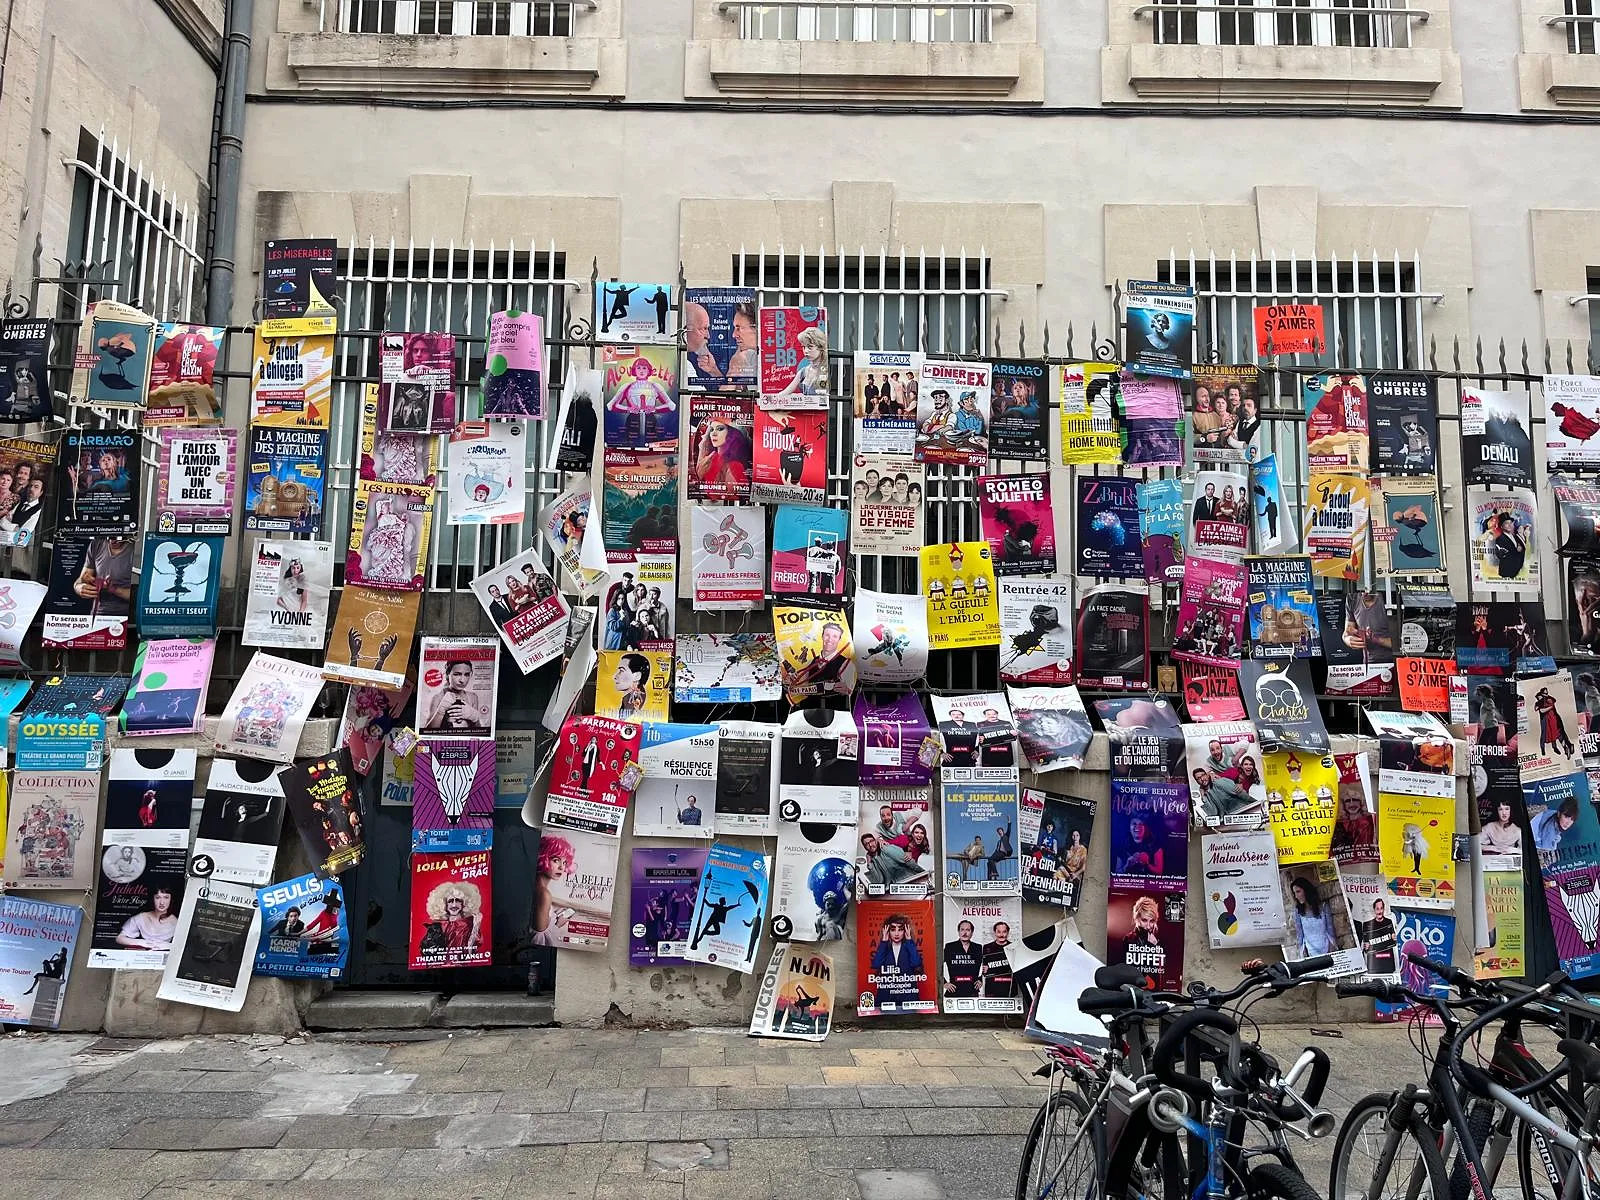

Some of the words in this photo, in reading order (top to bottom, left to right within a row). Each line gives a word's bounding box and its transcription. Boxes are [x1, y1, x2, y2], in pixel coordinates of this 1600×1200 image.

[268, 251, 282, 260] LES
[283, 248, 333, 259] MISÉRABLES
[1153, 297, 1193, 309] FRANKENSTEIN
[1268, 307, 1287, 317] ON
[1290, 306, 1307, 316] VA
[503, 323, 531, 332] compris
[1264, 318, 1316, 332] S'AIMER
[3, 330, 46, 340] OMBRES
[500, 336, 516, 344] bleu
[183, 352, 192, 361] DE
[182, 359, 197, 368] CHEZ
[181, 366, 203, 376] MAXIM
[266, 361, 303, 382] Chioggia
[932, 365, 966, 379] DÎNER
[967, 372, 987, 387] EX
[1373, 387, 1428, 397] OMBRES
[1344, 404, 1353, 413] DE
[1345, 412, 1360, 420] CHEZ
[876, 421, 916, 429] TÉMÉRAIRES
[1345, 419, 1366, 428] MAXIM
[69, 436, 134, 447] BARBARO
[259, 431, 274, 441] LA
[276, 432, 320, 444] MACHINE
[763, 432, 796, 452] BIJOUX
[1069, 437, 1094, 449] HOME
[182, 443, 216, 454] FAITES
[255, 442, 274, 454] DES
[277, 443, 322, 456] ENFANTS!
[1481, 444, 1518, 463] DENALI
[177, 455, 220, 466] L'AMOUR
[185, 466, 211, 477] AVEC
[190, 477, 204, 488] UN
[615, 474, 629, 482] LES
[363, 483, 382, 493] LES
[181, 489, 212, 500] BELGE
[775, 489, 803, 500] Notre-Dame
[987, 491, 1044, 504] JULIETTE
[860, 510, 874, 518] UN
[877, 511, 914, 519] VISAGE
[1319, 508, 1353, 529] Chioggia
[860, 519, 875, 527] DE
[877, 519, 914, 528] FEMME
[1212, 523, 1237, 533] T'AIME
[640, 562, 672, 571] HISTOIRES
[1251, 562, 1264, 573] LA
[1266, 562, 1306, 573] MACHINE
[774, 571, 808, 586] FRÈRE(S)
[1250, 573, 1265, 584] DES
[1267, 572, 1310, 584] ENFANTS!
[1003, 584, 1049, 596] Rentrée
[1052, 585, 1067, 596] 42
[933, 602, 946, 610] LA
[950, 597, 989, 610] GUEULE
[270, 611, 312, 626] YVONNE
[777, 610, 843, 626] TOPICK!
[940, 613, 985, 625] L'EMPLOI
[160, 645, 186, 653] quittez
[187, 645, 202, 653] pas
[1409, 661, 1427, 673] ON
[1431, 661, 1447, 674] VA
[1407, 674, 1448, 688] S'AIME
[1206, 680, 1229, 698] JAZZ
[23, 720, 99, 737] ODYSSÉE
[583, 717, 624, 730] BARBARA
[1203, 722, 1251, 736] NORMALES
[689, 739, 714, 747] 15h50
[1138, 737, 1147, 745] LE
[1148, 737, 1159, 745] JEU
[1122, 746, 1133, 755] DE
[1134, 746, 1160, 756] L'AMOUR
[1488, 745, 1508, 757] ROBE
[664, 760, 713, 769] RÉSILIENCE
[1114, 756, 1122, 764] ET
[1124, 756, 1133, 764] DU
[1134, 756, 1160, 765] HASARD
[670, 768, 693, 776] MON
[695, 768, 713, 777] CUL
[18, 778, 97, 788] COLLECTION
[1538, 780, 1576, 795] Amandine
[860, 790, 876, 800] LES
[877, 790, 928, 800] NORMALES
[1120, 786, 1148, 795] SOPHIE
[1151, 787, 1178, 796] BELVISI
[1544, 790, 1574, 802] Lourdel
[601, 793, 617, 803] 14h
[947, 794, 965, 802] LES
[967, 794, 1015, 802] JUMEAUX
[1153, 795, 1188, 815] Mère
[1273, 814, 1288, 823] LA
[1292, 810, 1334, 821] GUEULE
[1282, 826, 1331, 838] L'EMPLOI
[1208, 842, 1241, 851] Monsieur
[1208, 850, 1270, 864] Malaussène
[416, 860, 449, 873] LOLLA
[454, 854, 487, 867] WESH
[462, 867, 489, 879] DRAG
[565, 873, 580, 882] LA
[581, 875, 613, 887] BELLE
[262, 878, 324, 908] SEUL(S)
[4, 901, 77, 922] EUROPEANA
[1392, 912, 1445, 946] Yoko
[40, 928, 74, 943] Siècle
[270, 938, 300, 947] KARIM
[269, 945, 298, 954] MENDIL
[1128, 944, 1164, 953] Elisabeth
[461, 952, 484, 961] L'ANGE
[1126, 953, 1166, 966] BUFFET
[295, 966, 329, 974] CASERNE
[881, 966, 901, 974] Lilia
[868, 974, 927, 983] Benchabane
[753, 948, 786, 1028] LUCIOLES
[1532, 1126, 1559, 1185] KRIDER
